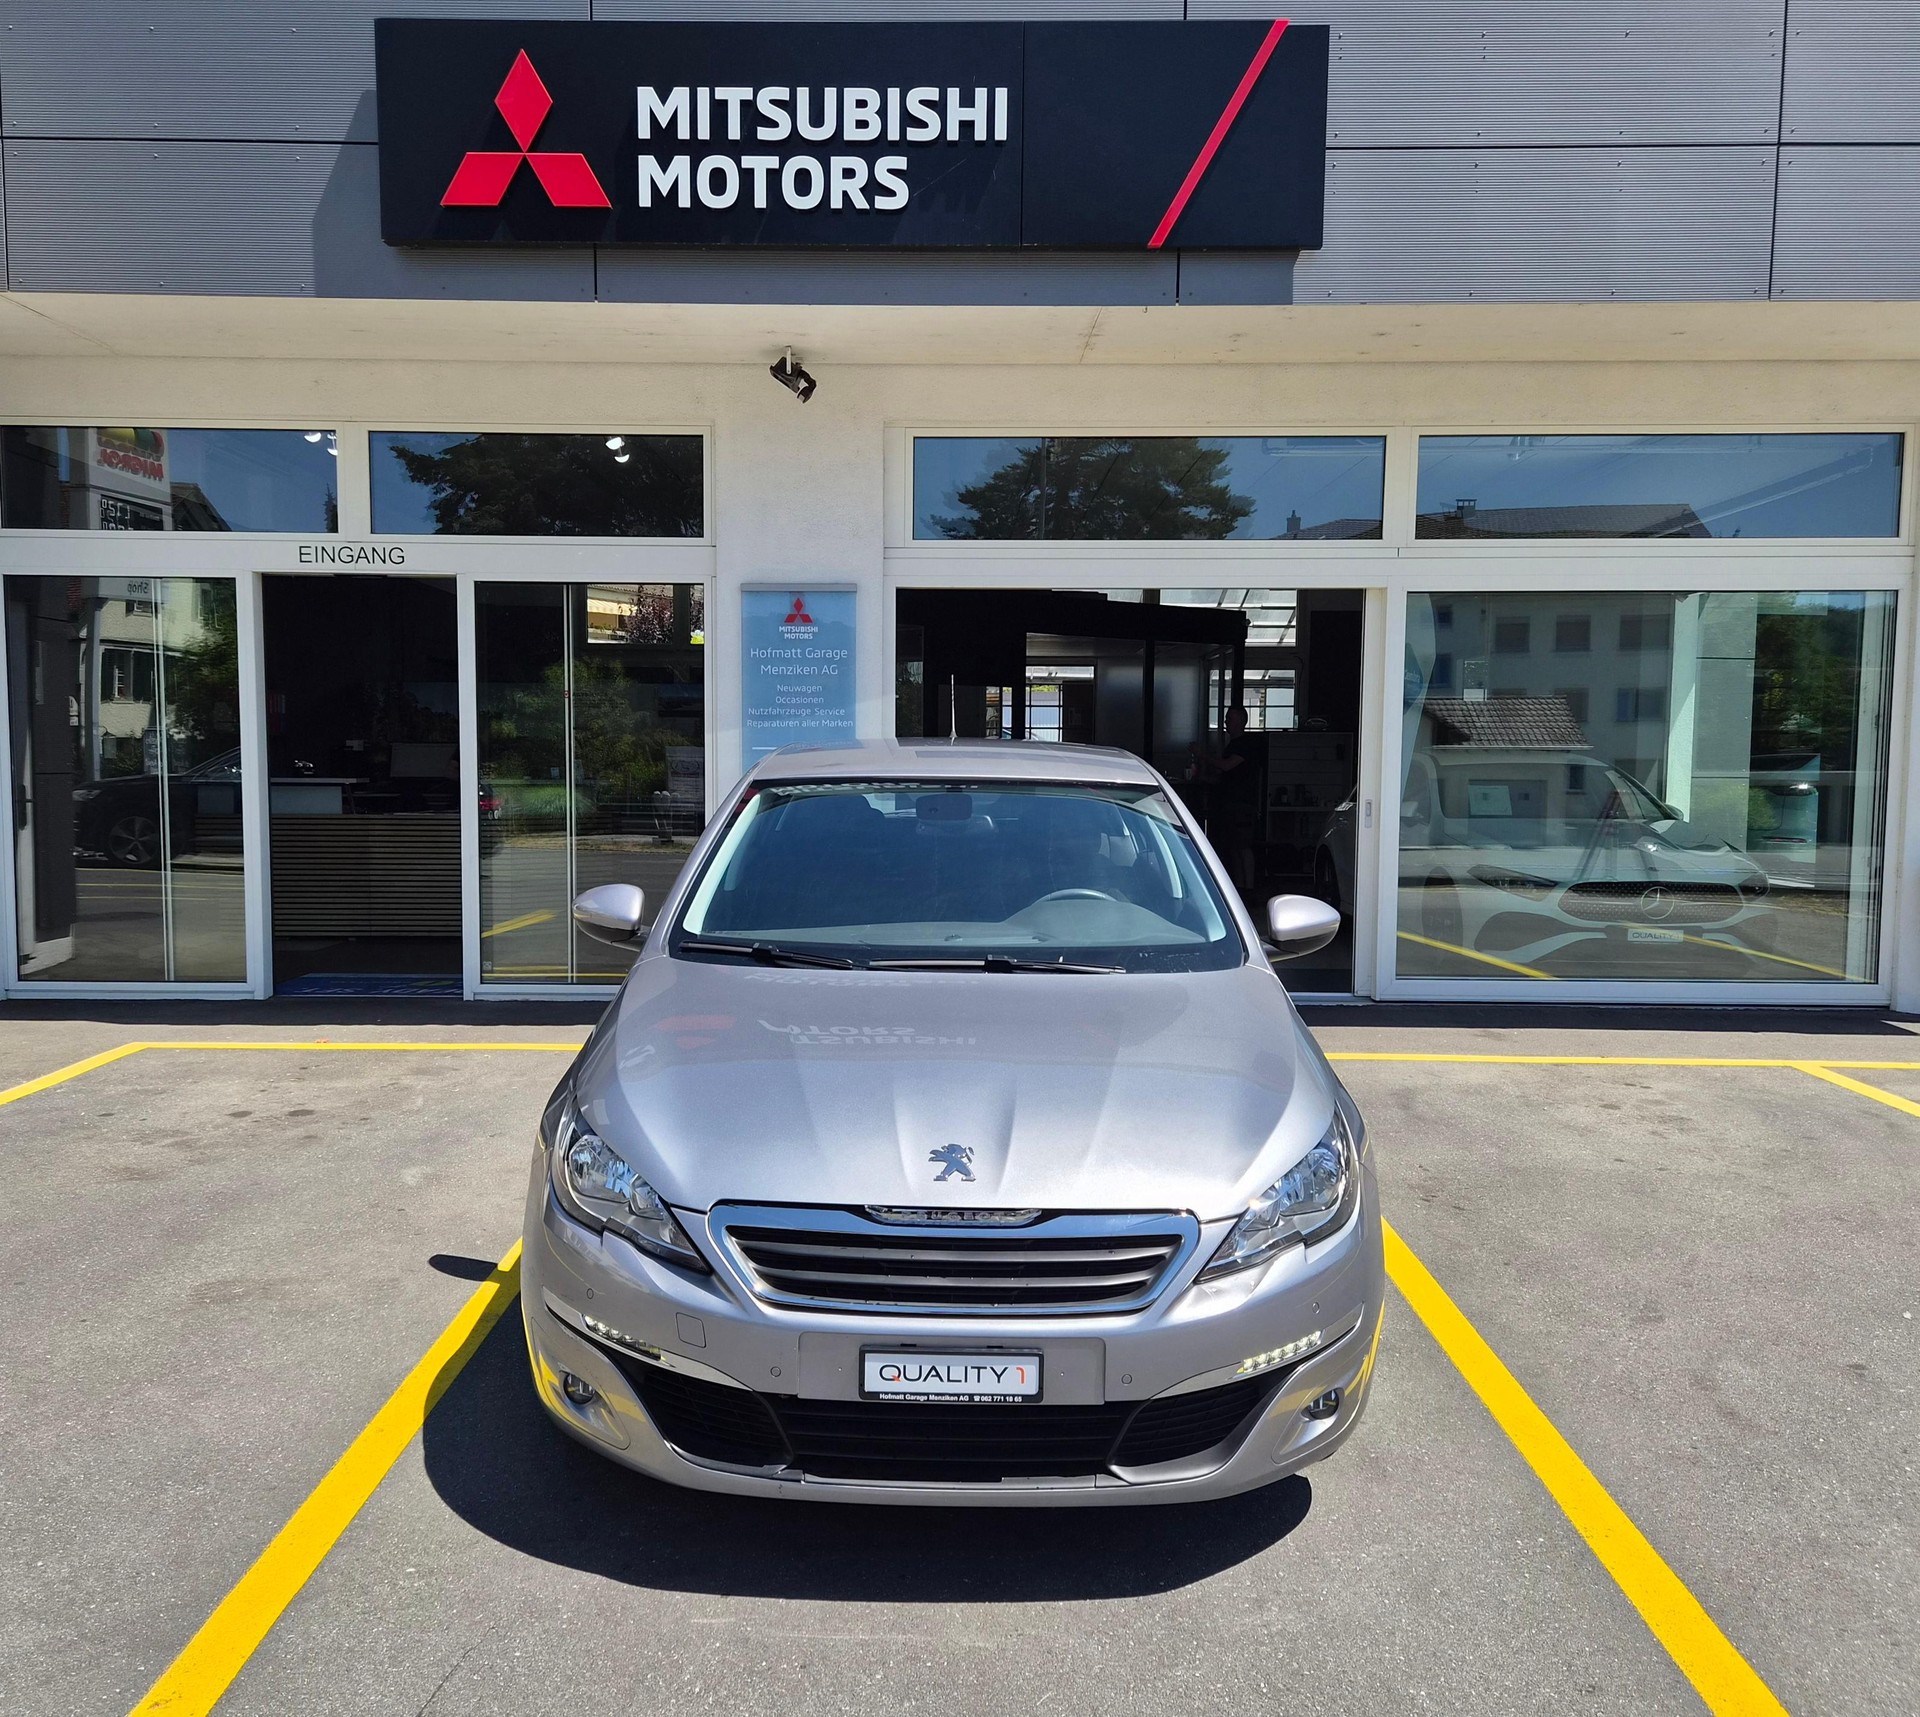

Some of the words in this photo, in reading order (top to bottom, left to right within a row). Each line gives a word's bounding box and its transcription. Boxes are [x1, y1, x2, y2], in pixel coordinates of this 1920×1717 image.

[637, 86, 1008, 142] MITSUBISHI
[638, 154, 910, 210] MOTORS
[299, 545, 405, 565] EINGANG
[750, 647, 801, 658] Hofmatt
[805, 647, 848, 660] Garage
[760, 664, 818, 675] Menziken
[821, 665, 838, 675] AG
[777, 684, 823, 693] Neuwagen
[775, 695, 824, 704] Occasionen
[748, 707, 811, 717] Nutzfahrzeuge
[814, 708, 845, 716] Service
[747, 719, 800, 729] Reparaturen
[801, 719, 819, 728] aller
[822, 719, 854, 728] Marken
[879, 1364, 1009, 1384] QUALITY
[1016, 1367, 1025, 1384] 1
[905, 1394, 928, 1402] Garage
[928, 1394, 958, 1402] Menziken
